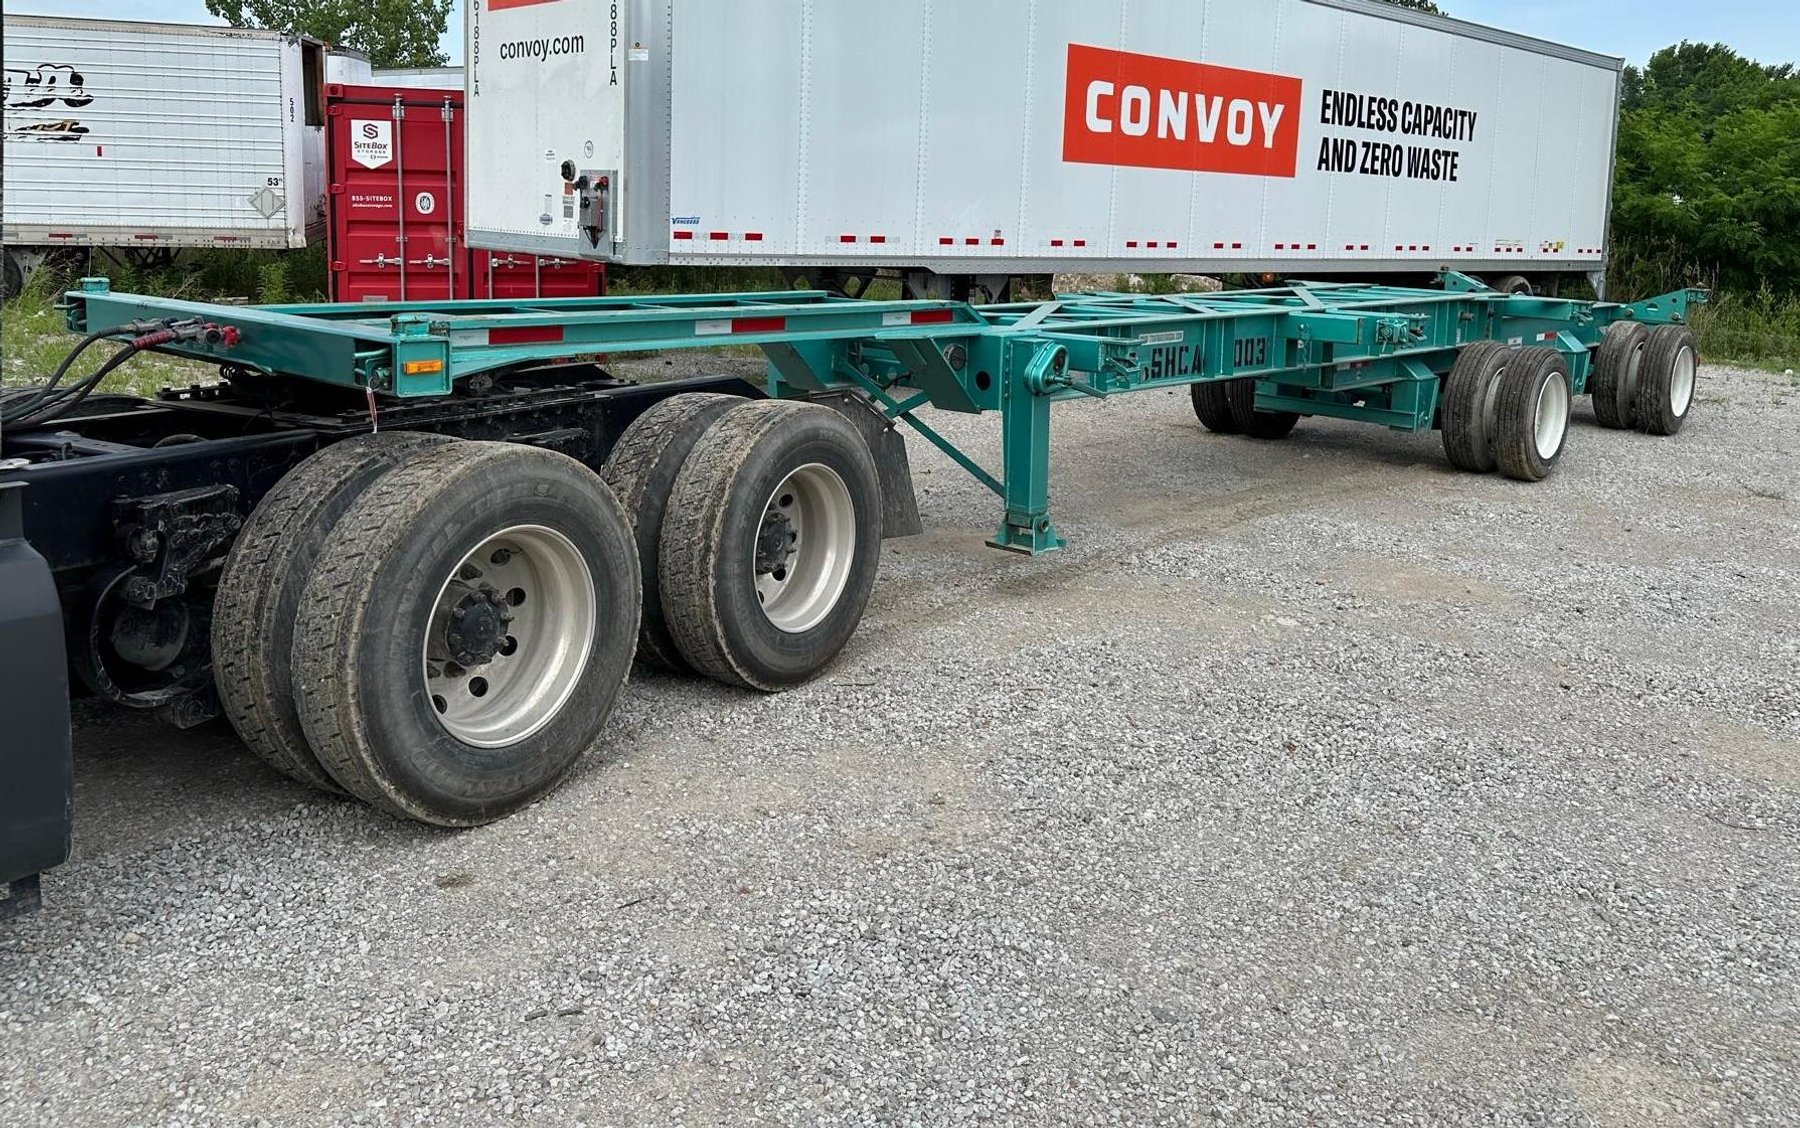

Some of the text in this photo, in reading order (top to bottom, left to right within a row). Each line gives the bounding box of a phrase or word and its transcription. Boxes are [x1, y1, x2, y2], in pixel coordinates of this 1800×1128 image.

[500, 34, 584, 62] convoy.com
[609, 0, 618, 86] 88PLA
[1085, 80, 1285, 149] CONVOY
[1320, 89, 1477, 142] ENDLESS CAPACITY
[1317, 137, 1459, 182] AND ZERO WASTE
